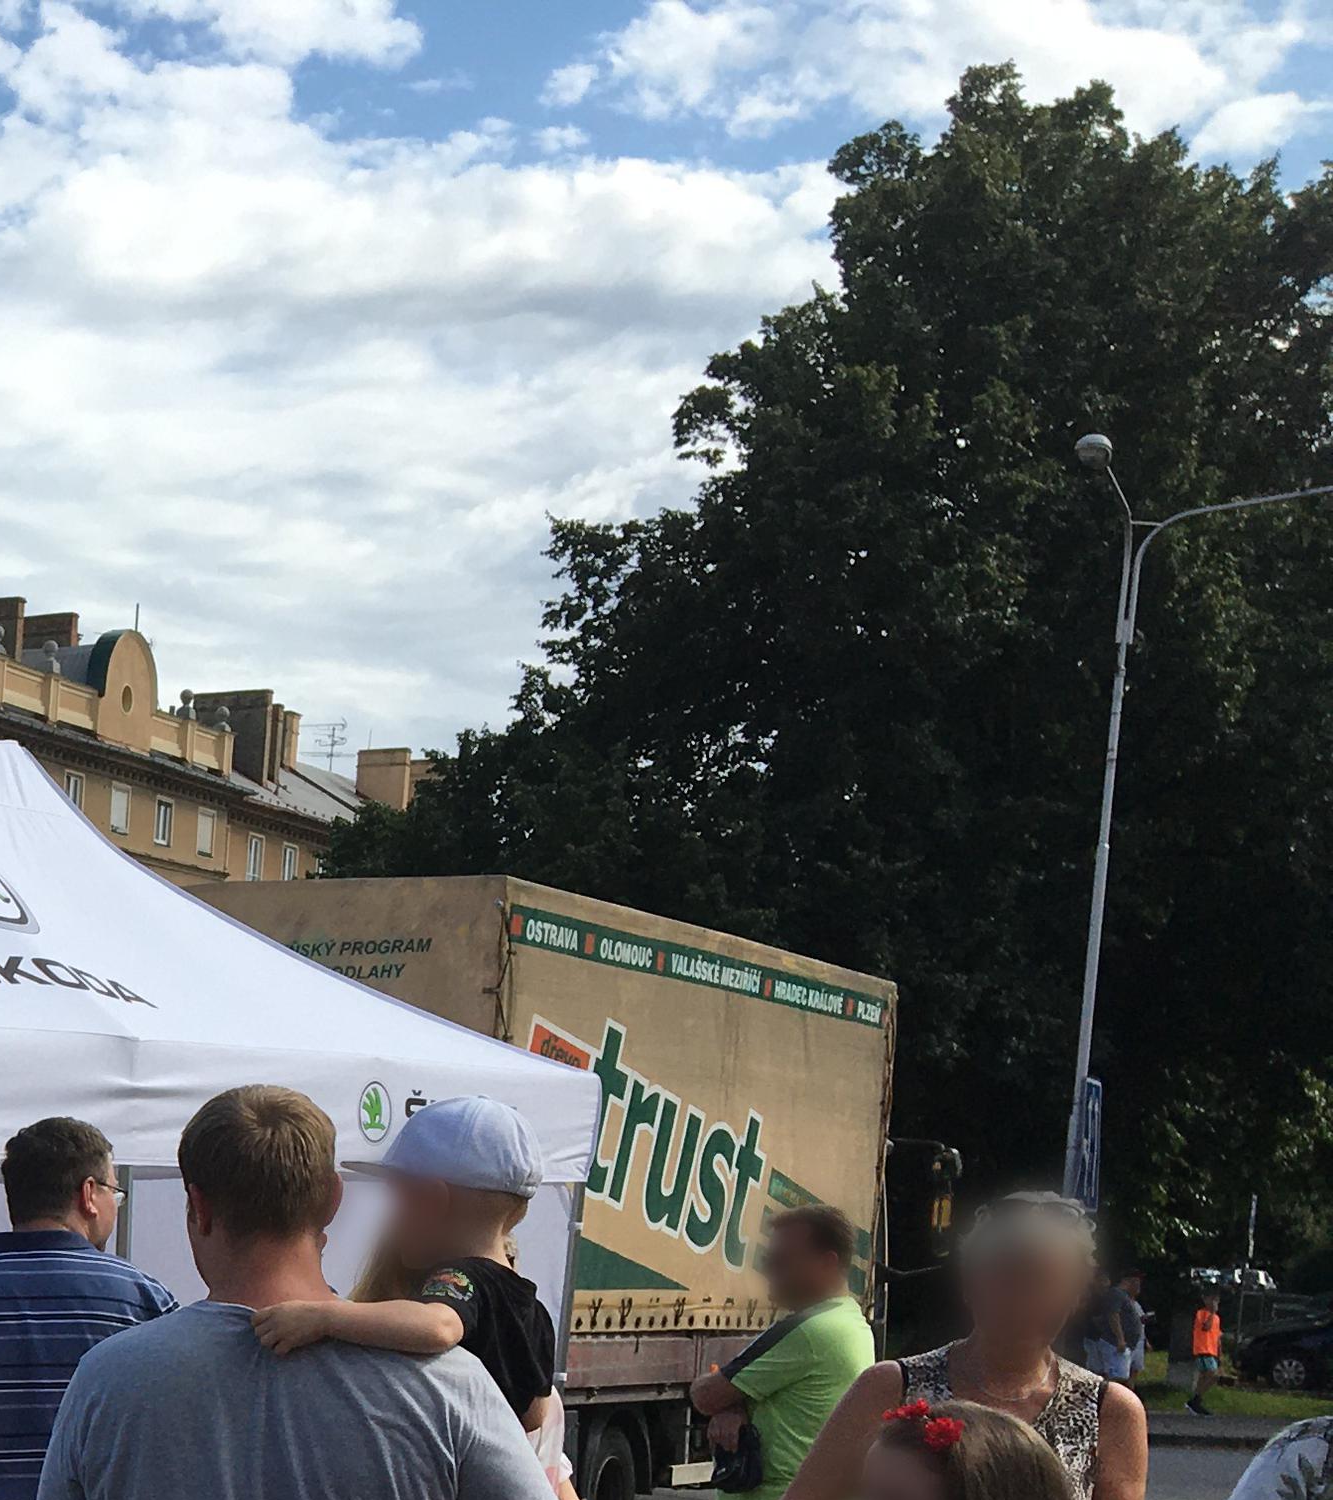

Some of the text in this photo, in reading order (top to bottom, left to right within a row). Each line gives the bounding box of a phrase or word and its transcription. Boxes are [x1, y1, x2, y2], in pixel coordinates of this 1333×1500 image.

[339, 937, 432, 956] PROGRAM
[526, 919, 578, 951] OSTRAVA
[600, 938, 653, 968] OLOMOUC
[671, 953, 721, 984] VALAŠSKÉ
[774, 979, 807, 1006] HRADEC
[807, 988, 844, 1015] KRÁLOVÉ
[585, 1019, 767, 1272] trust
